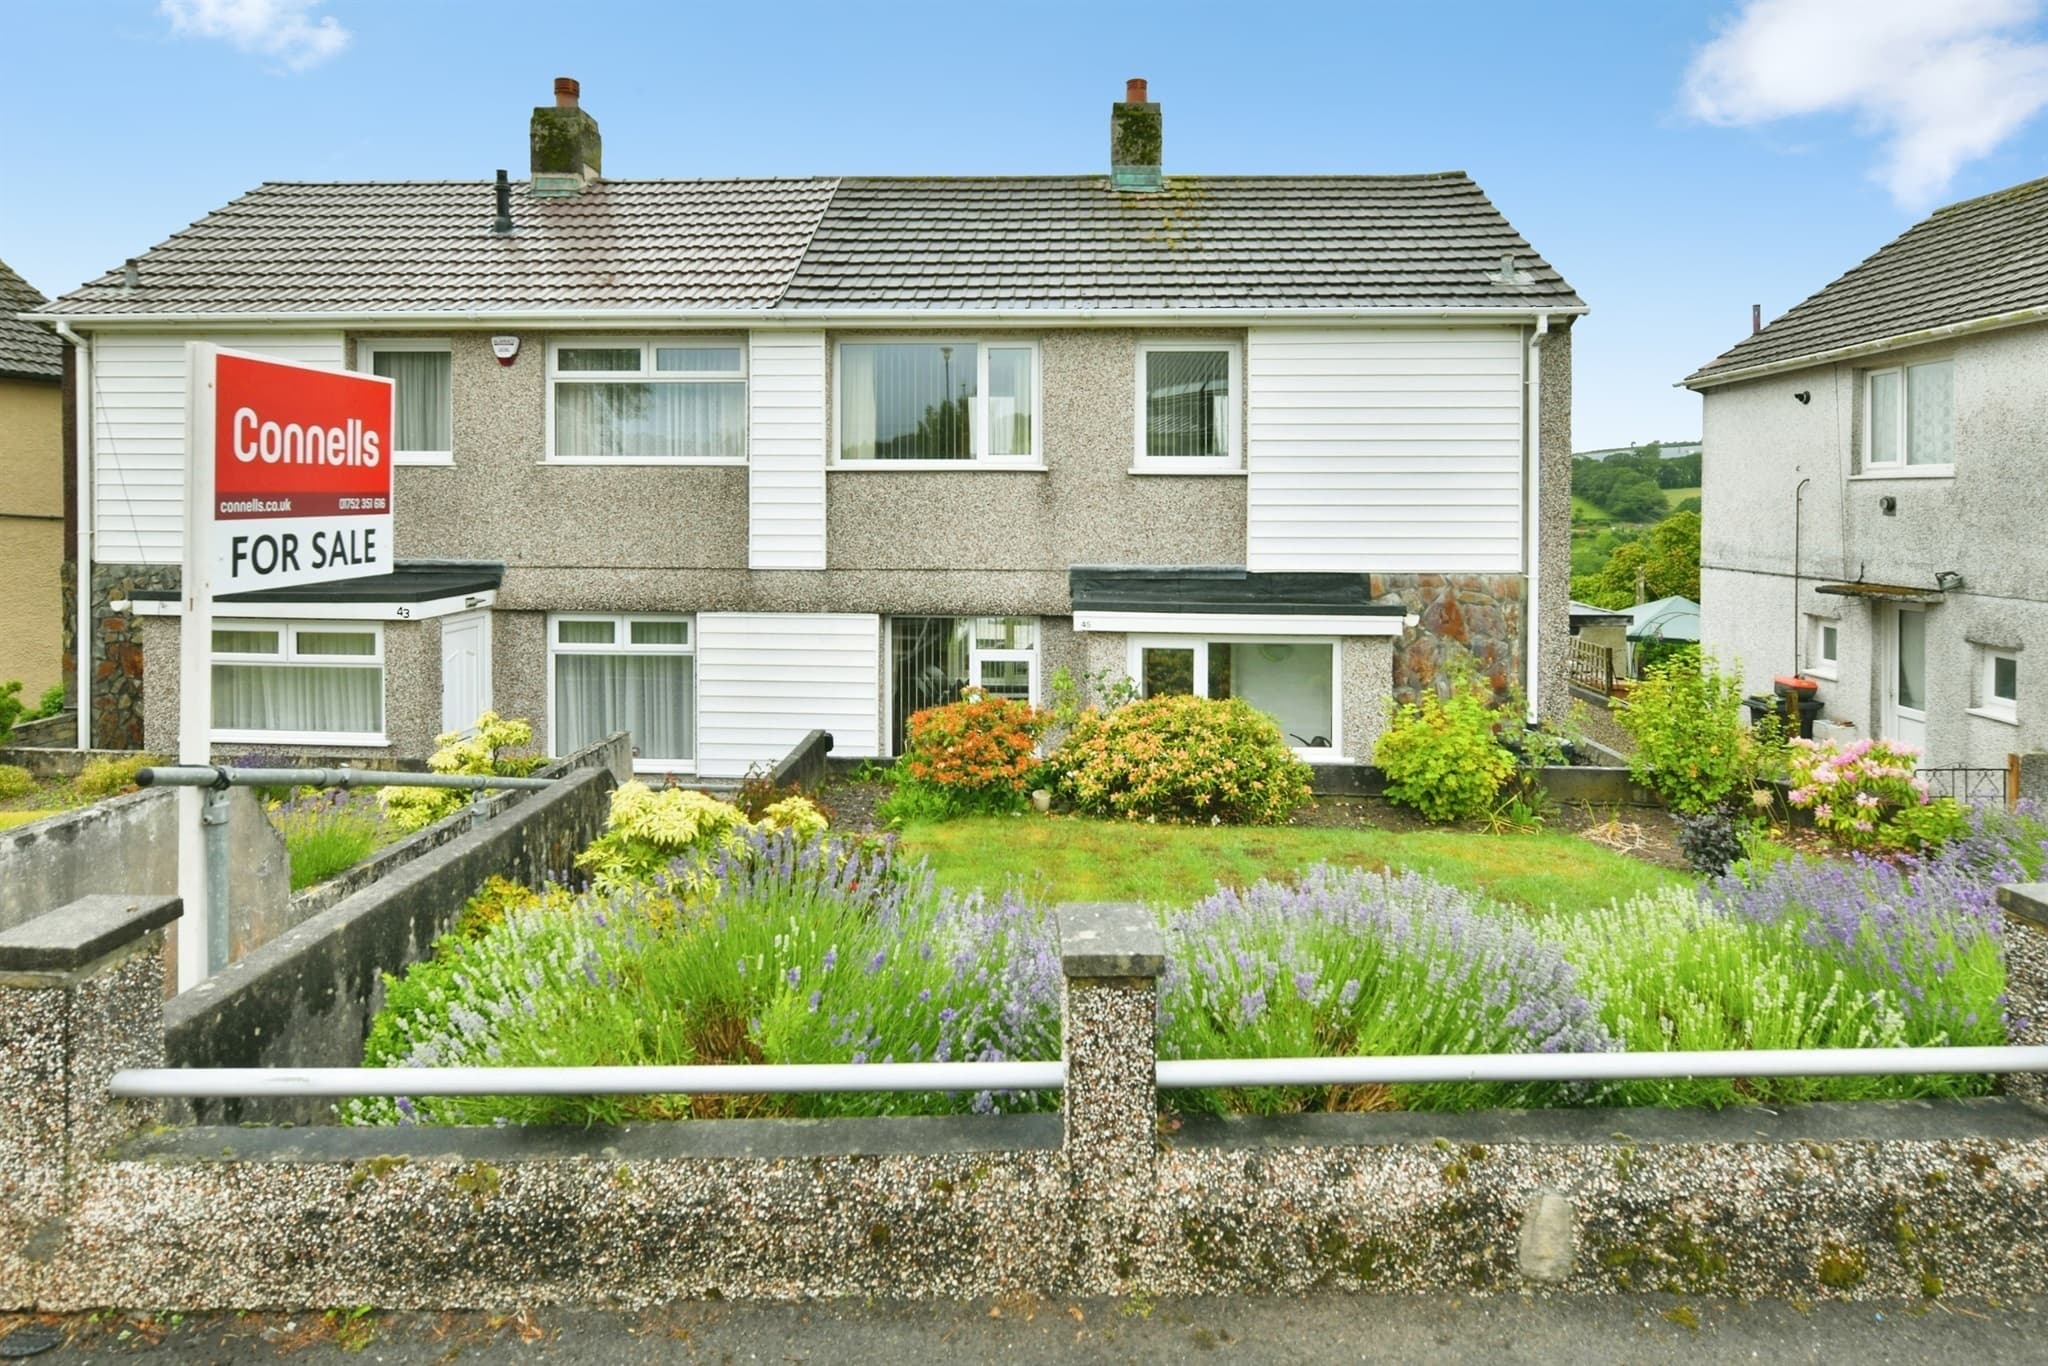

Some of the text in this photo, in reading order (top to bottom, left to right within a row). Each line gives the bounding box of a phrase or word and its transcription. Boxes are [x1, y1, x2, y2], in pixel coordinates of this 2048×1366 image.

[233, 406, 380, 467] Connells
[220, 498, 292, 513] connells.co.uk
[232, 528, 376, 578] FOR SALE
[396, 606, 410, 618] 43
